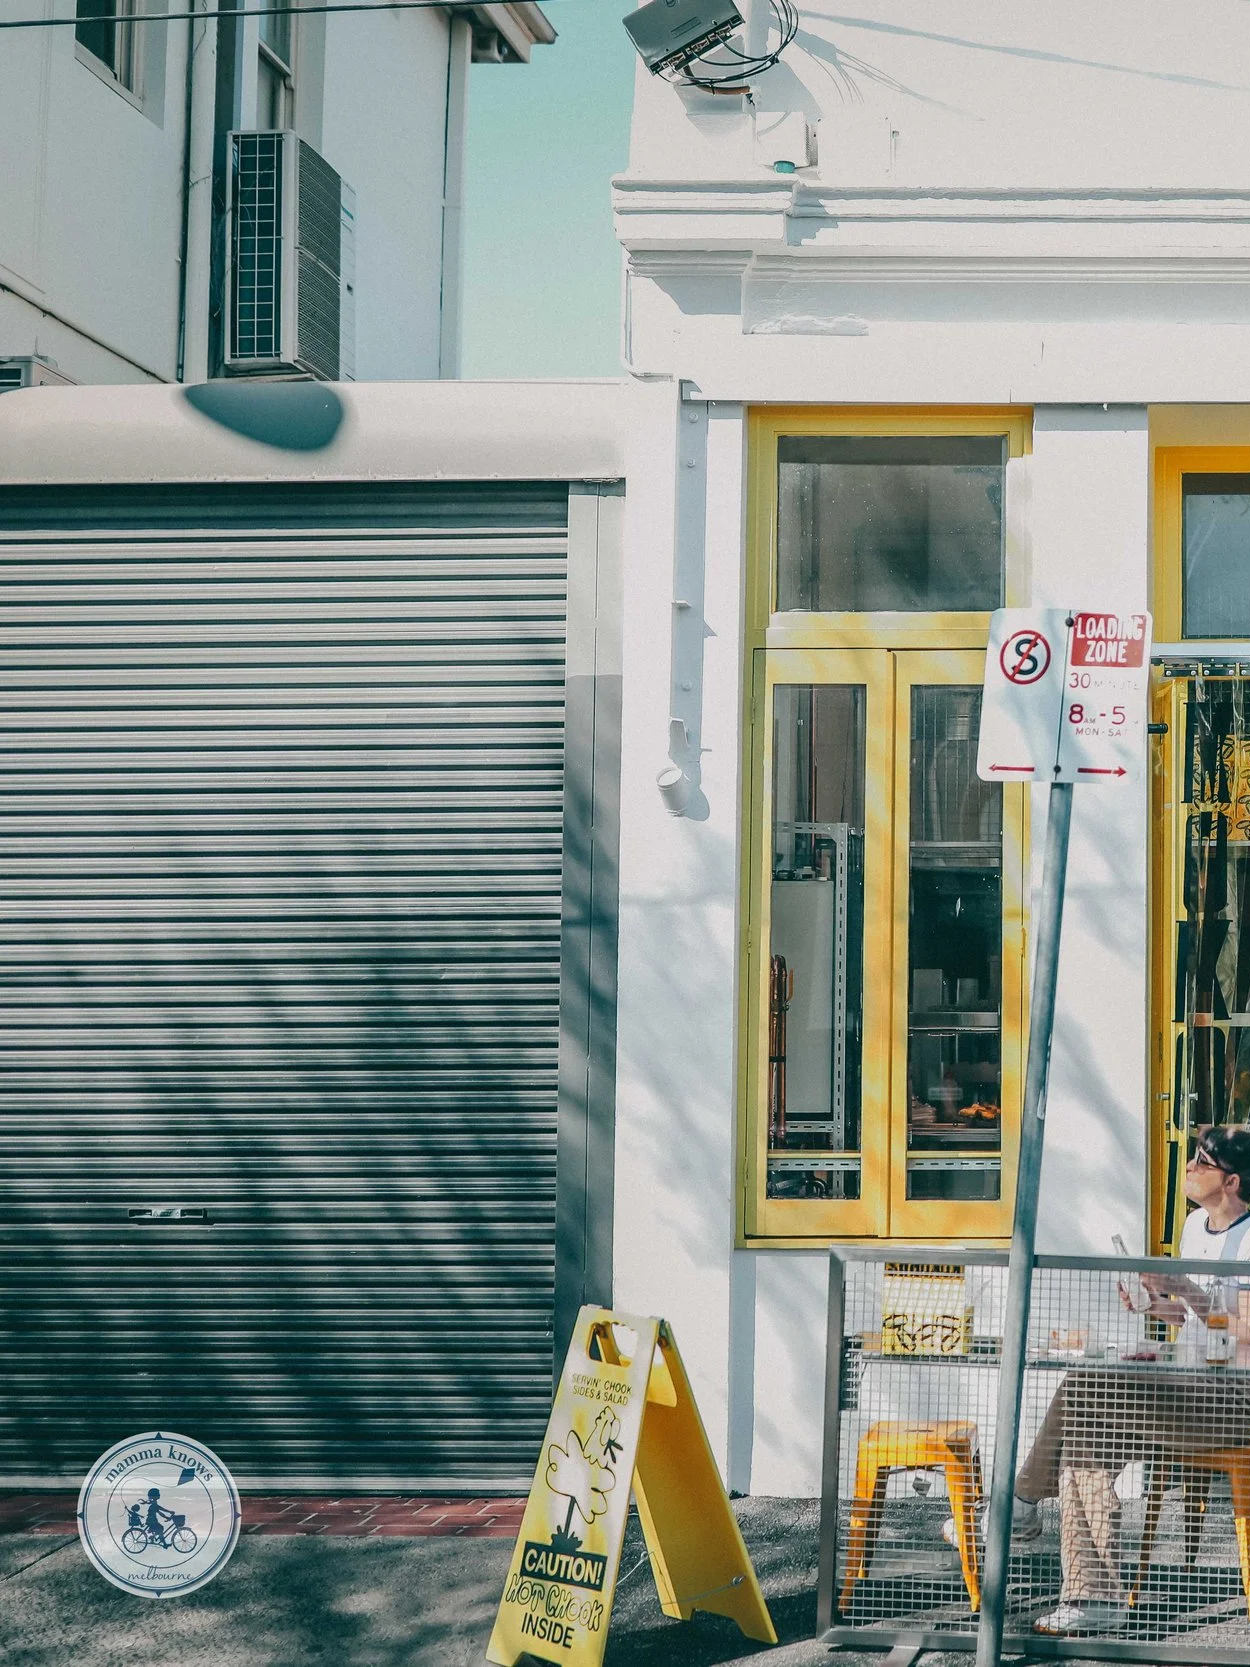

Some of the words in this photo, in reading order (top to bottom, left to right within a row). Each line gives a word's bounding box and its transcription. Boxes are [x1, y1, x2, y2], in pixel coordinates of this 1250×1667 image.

[1076, 616, 1144, 641] LOADING
[1084, 640, 1129, 663] ZONE
[1069, 672, 1091, 689] 30
[572, 1385, 595, 1399] SIDES
[596, 1390, 601, 1400] &
[603, 1391, 629, 1406] SALAD
[603, 1380, 632, 1395] CHOOK
[524, 1548, 604, 1586] CAUTION!
[506, 1573, 546, 1612] HOT
[545, 1584, 604, 1632] CHOOK
[521, 1612, 575, 1649] INSIDE
